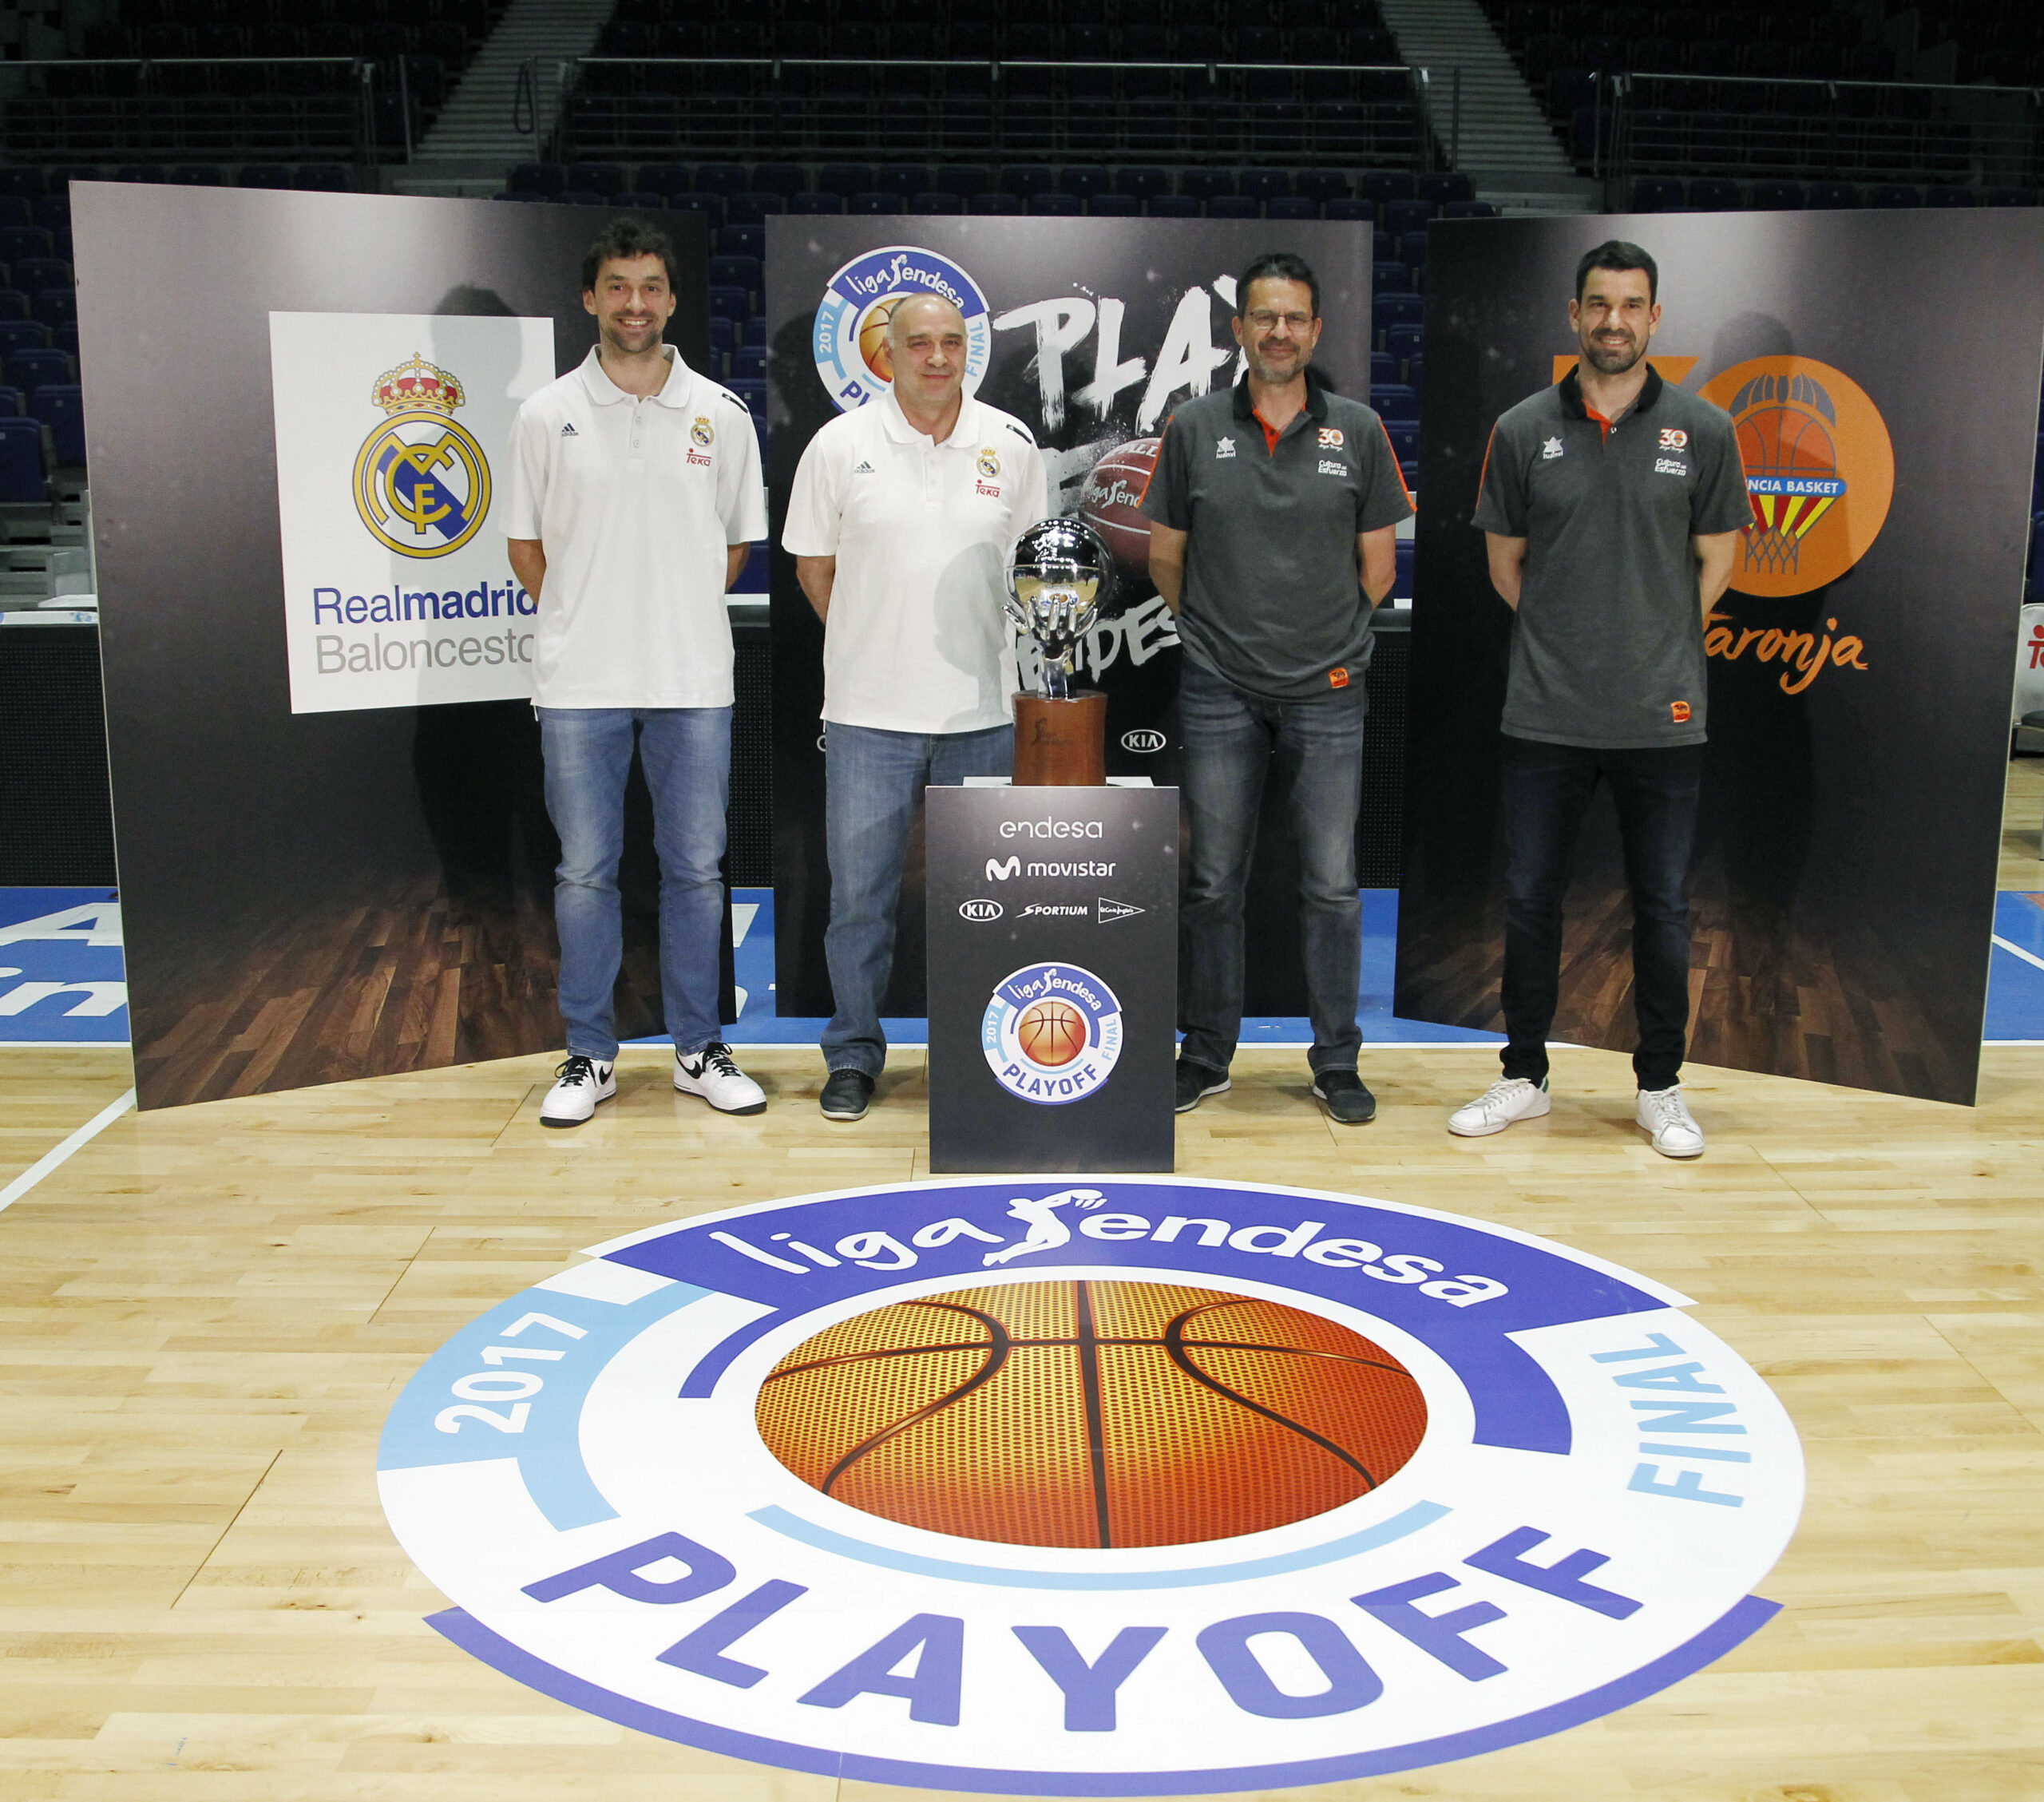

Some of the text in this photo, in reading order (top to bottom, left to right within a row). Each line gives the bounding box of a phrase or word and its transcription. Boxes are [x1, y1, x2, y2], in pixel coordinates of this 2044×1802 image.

[846, 267, 965, 309] liga endesa
[819, 311, 834, 354] 2017
[965, 322, 984, 377] FINAL
[1787, 481, 1839, 493] BASKET
[1128, 735, 1159, 748] KIA
[999, 816, 1103, 838] endesa
[1027, 860, 1116, 877] movistar
[966, 903, 997, 917] KIA
[1016, 902, 1088, 918] SPORTIUM
[1007, 976, 1102, 1012] liga endesa
[986, 1011, 999, 1044] 2017
[1101, 1018, 1117, 1061] FINAL
[1003, 1063, 1098, 1096] PLAYOFF
[709, 1212, 1509, 1308] liga endesa
[434, 1312, 588, 1435] 2017
[1588, 1332, 1753, 1507] FINAL
[520, 1525, 1645, 1733] PLAYOFF
